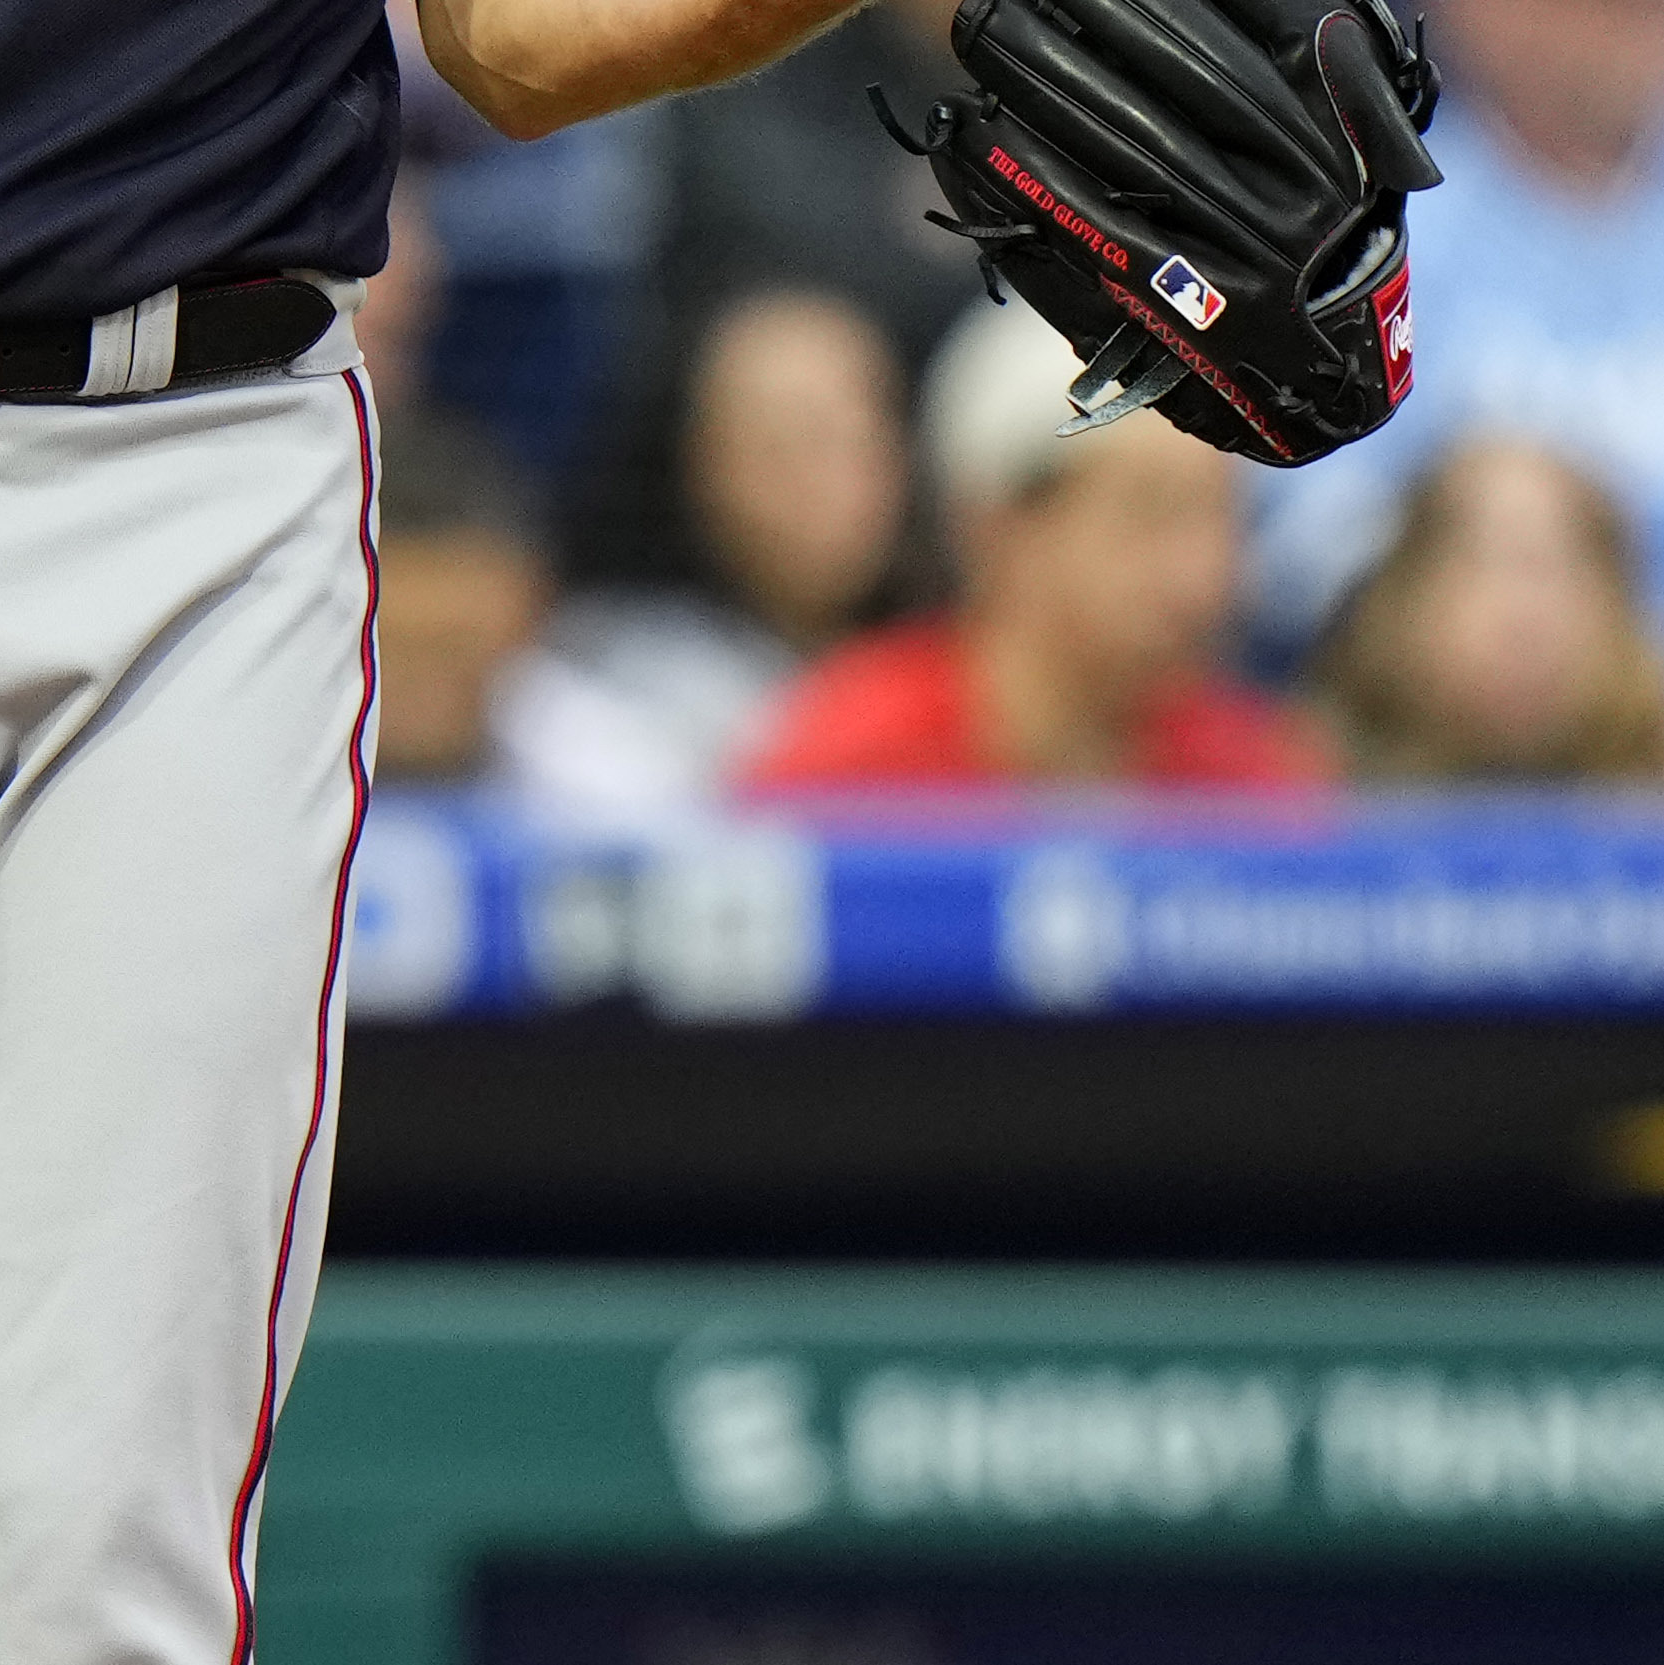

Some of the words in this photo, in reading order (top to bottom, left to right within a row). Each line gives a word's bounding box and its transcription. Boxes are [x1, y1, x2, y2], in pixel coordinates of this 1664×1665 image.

[987, 145, 1020, 181] THE
[1014, 170, 1056, 212] GOLD
[1052, 203, 1105, 253] GLOVE
[1101, 241, 1130, 272] CO.
